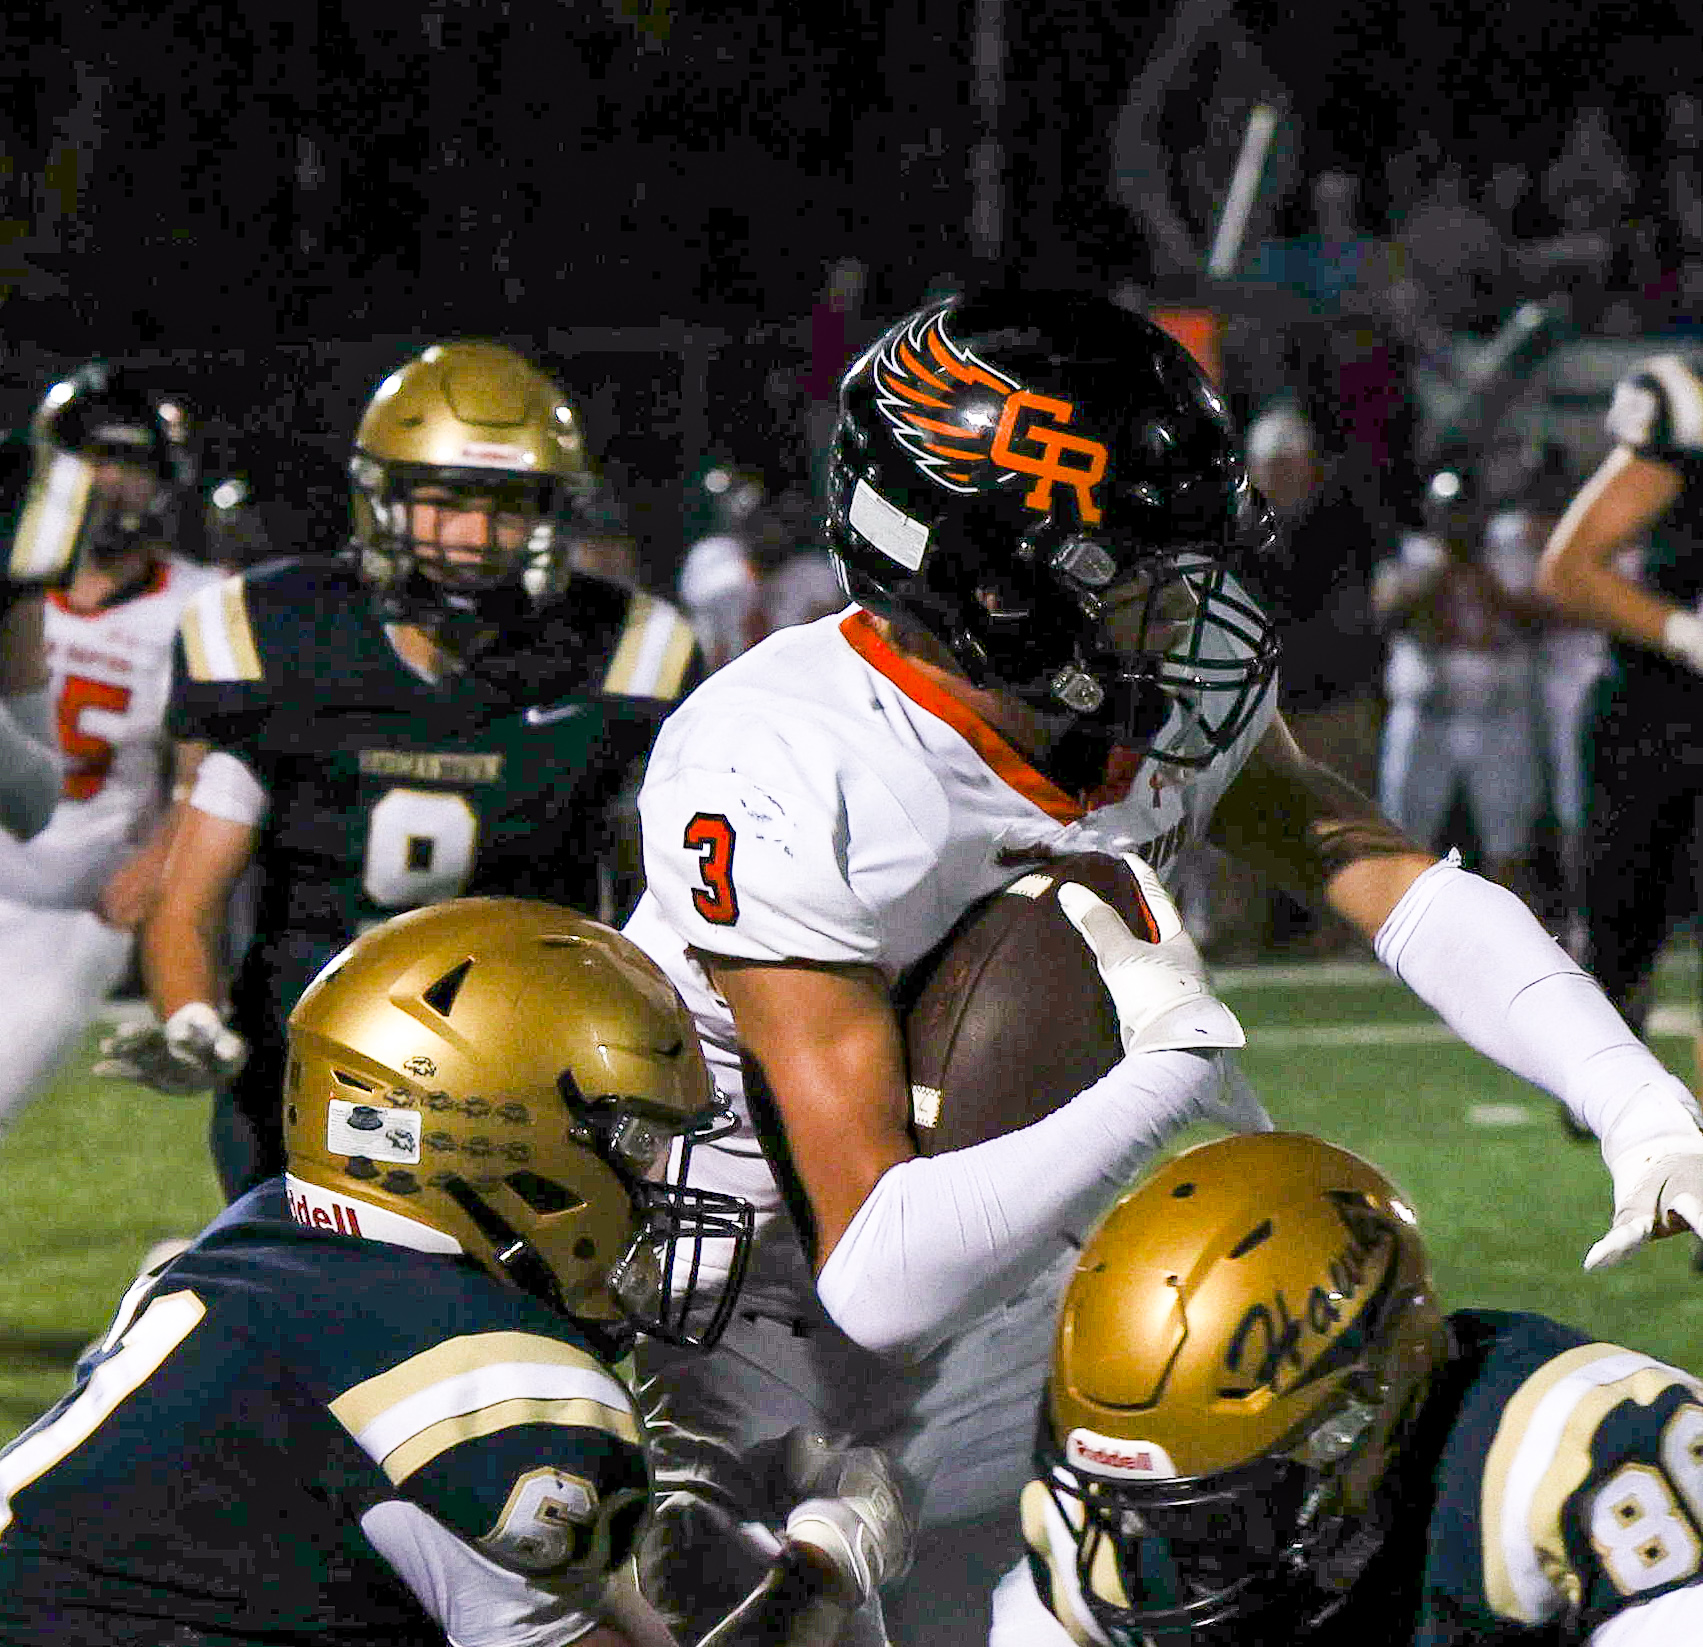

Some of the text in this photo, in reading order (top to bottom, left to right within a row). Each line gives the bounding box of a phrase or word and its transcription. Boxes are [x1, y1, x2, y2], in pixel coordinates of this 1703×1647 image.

[57, 673, 132, 802] 5
[683, 811, 740, 927] 3
[287, 1190, 363, 1239] dell
